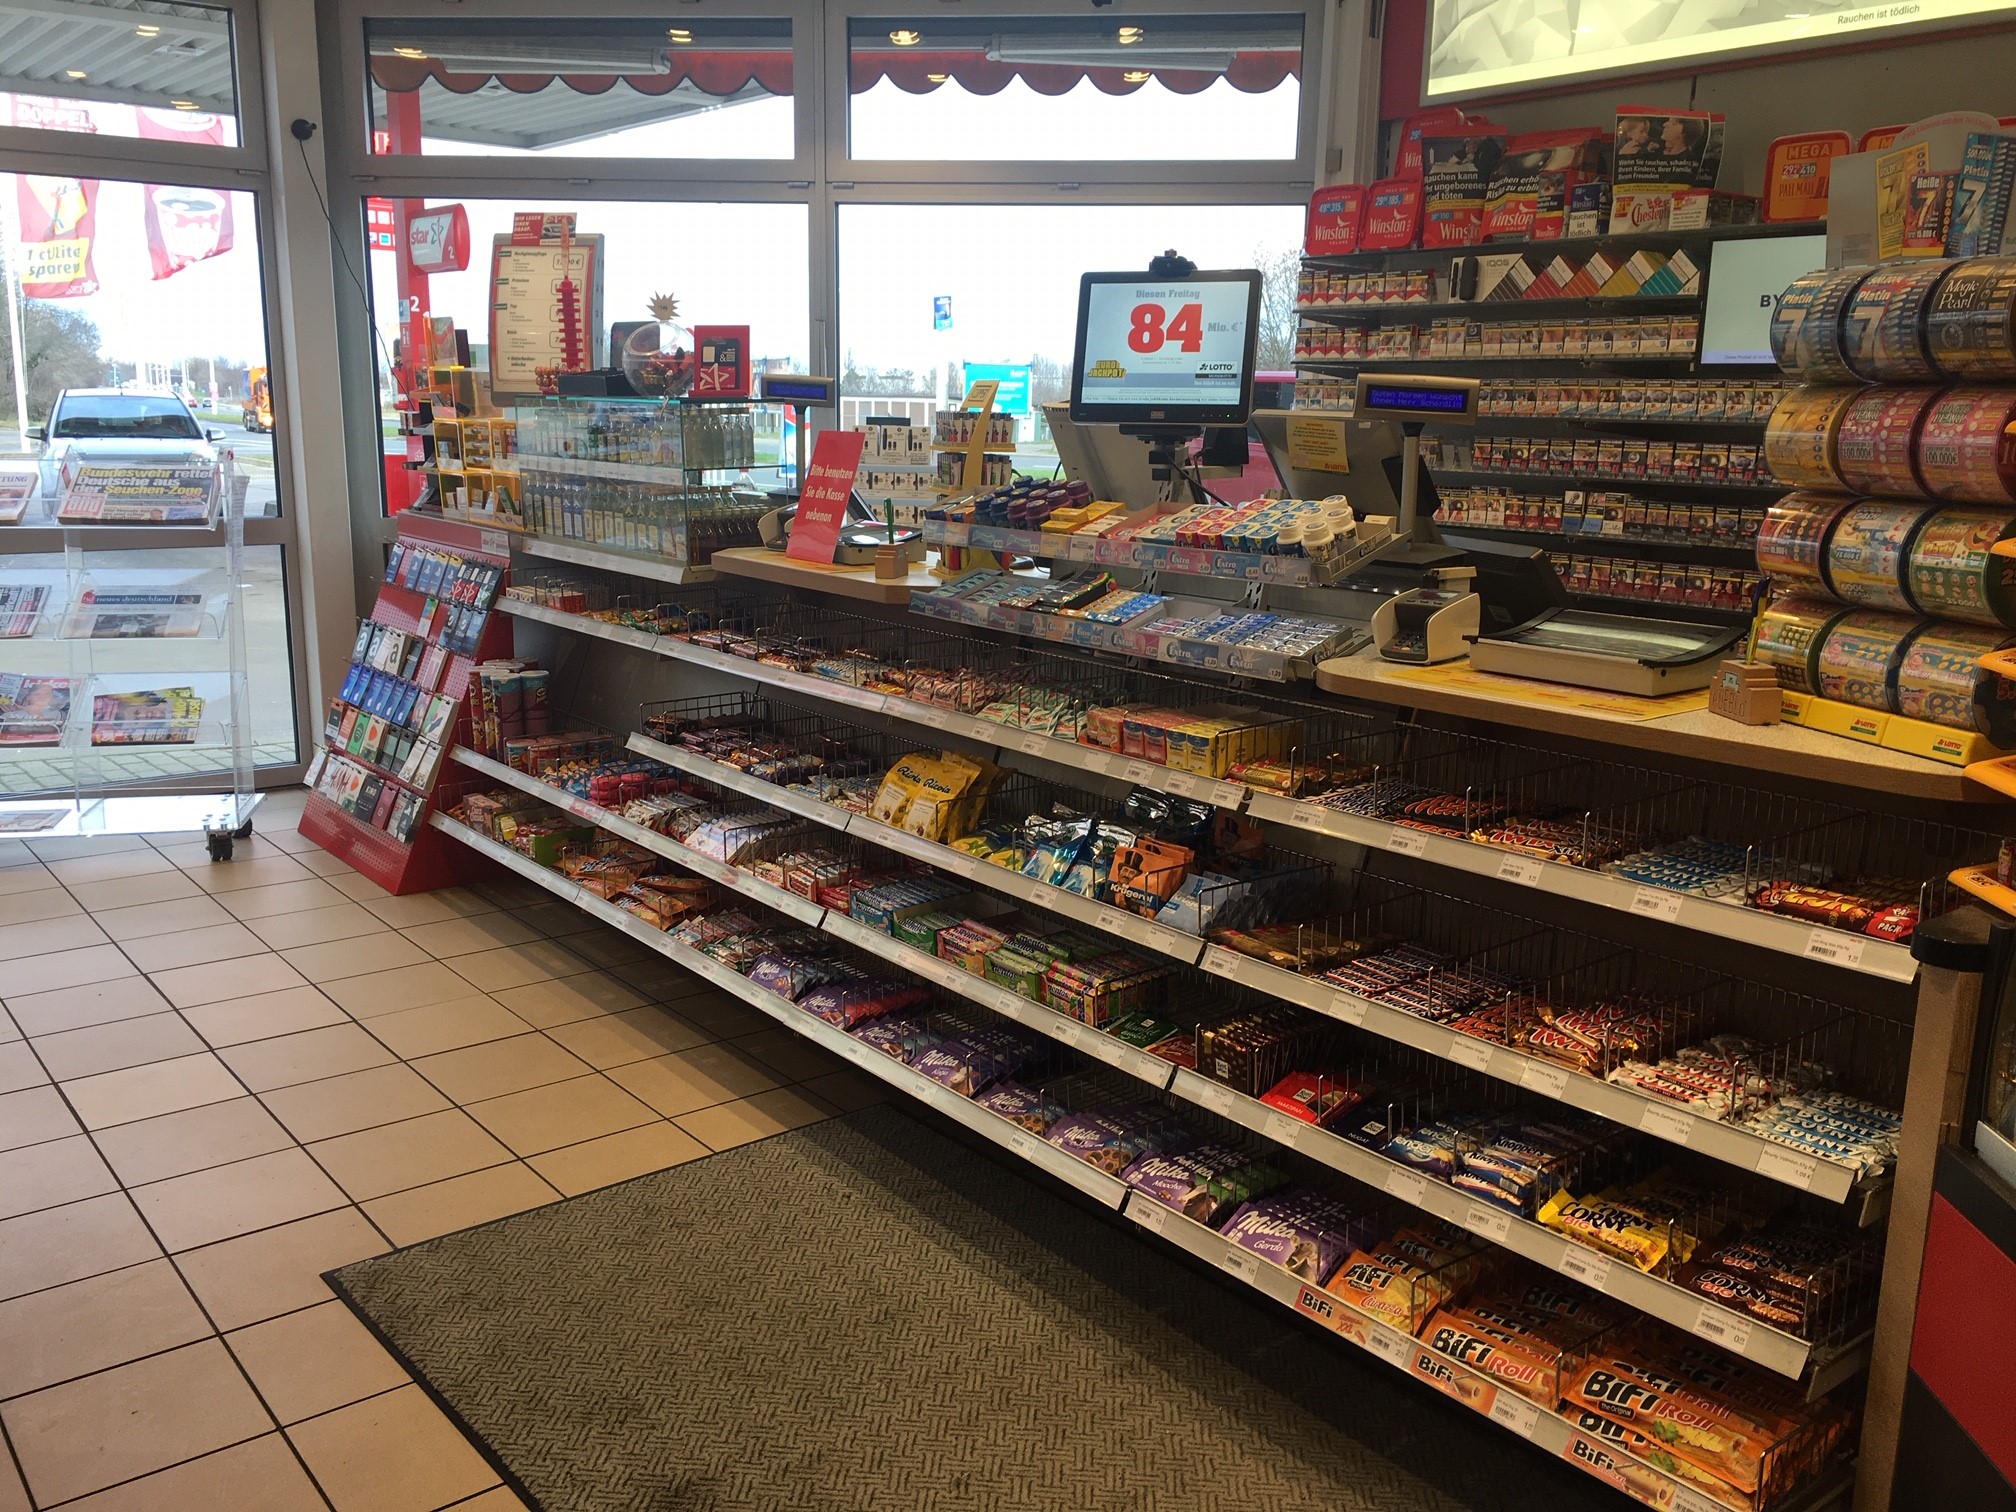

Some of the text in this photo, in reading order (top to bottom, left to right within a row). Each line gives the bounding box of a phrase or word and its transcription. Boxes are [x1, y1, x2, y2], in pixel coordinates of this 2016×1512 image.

[1838, 4, 1920, 24] Rauchen ist tödlich
[1788, 144, 1830, 158] MEGA
[1458, 172, 1478, 180] kann
[1520, 175, 1540, 184] erhö
[1964, 165, 1990, 178] Platin
[1434, 182, 1486, 192] ungeborenes
[1916, 176, 1940, 188] Heiße
[1442, 191, 1463, 200] töten
[1956, 180, 1987, 224] 7
[1915, 190, 1938, 227] 7
[1315, 224, 1350, 240] Winston
[1370, 218, 1406, 234] Winston
[1440, 222, 1481, 240] Winsto
[411, 226, 430, 246] star
[448, 246, 454, 260] 2
[1486, 258, 1510, 268] IQOS
[1947, 279, 1978, 293] Magic
[1136, 289, 1200, 300] Diesen Freitag
[1784, 294, 1813, 305] Platin
[1858, 290, 1890, 302] Platin
[1939, 293, 1972, 310] Pearl
[410, 296, 420, 312] 2
[1128, 303, 1204, 354] 84
[1208, 322, 1230, 332] Mio.
[1778, 308, 1808, 367] 7
[1854, 306, 1884, 367] 7
[1087, 368, 1128, 379] JACKPOT
[1400, 391, 1427, 399] Morgen
[80, 467, 172, 478] Bundeswehr
[810, 464, 854, 480] Bitte benutzen
[76, 476, 180, 486] Deutsche aus
[74, 484, 204, 496] der Seuchen-Zone
[806, 485, 845, 502] Sie die Kasse
[805, 508, 832, 522] nebenan
[1172, 553, 1190, 564] Extra
[1216, 558, 1236, 570] Extra
[1266, 563, 1286, 576] Extra
[1112, 632, 1134, 647] Extra
[1168, 643, 1192, 658] Extra
[1230, 656, 1253, 669] Extra
[1784, 702, 1800, 711] LOTTO
[1861, 720, 1878, 730] LOTTO
[1944, 740, 1962, 750] LOTTO
[897, 766, 921, 784] Ricola
[923, 778, 952, 794] Ricola
[1110, 882, 1154, 903] Krügerol
[1784, 892, 1854, 912] LION
[1878, 922, 1903, 934] PACK
[1018, 934, 1050, 951] mentos
[1529, 1026, 1598, 1062] TWIX
[920, 1049, 960, 1068] Milka
[1064, 1125, 1100, 1141] Milka
[1348, 1132, 1370, 1144] NUGAT
[1774, 1124, 1864, 1156] BOUNTY
[1141, 1157, 1190, 1180] Milka
[1237, 1210, 1296, 1239] Milka
[1558, 1201, 1632, 1234] CORNY
[1562, 1214, 1590, 1230] BIG
[1253, 1240, 1284, 1253] Gerda
[1722, 1256, 1756, 1270] BIG
[1700, 1282, 1734, 1298] BIG
[1302, 1290, 1333, 1318] BiFi
[1431, 1326, 1496, 1365] BiFi
[1416, 1354, 1456, 1383] BiFi
[1487, 1354, 1539, 1384] Roll
[1583, 1370, 1661, 1413] BiFi
[1601, 1402, 1632, 1416] The Original
[1656, 1402, 1715, 1431] Roll
[1572, 1438, 1615, 1471] BiFi
